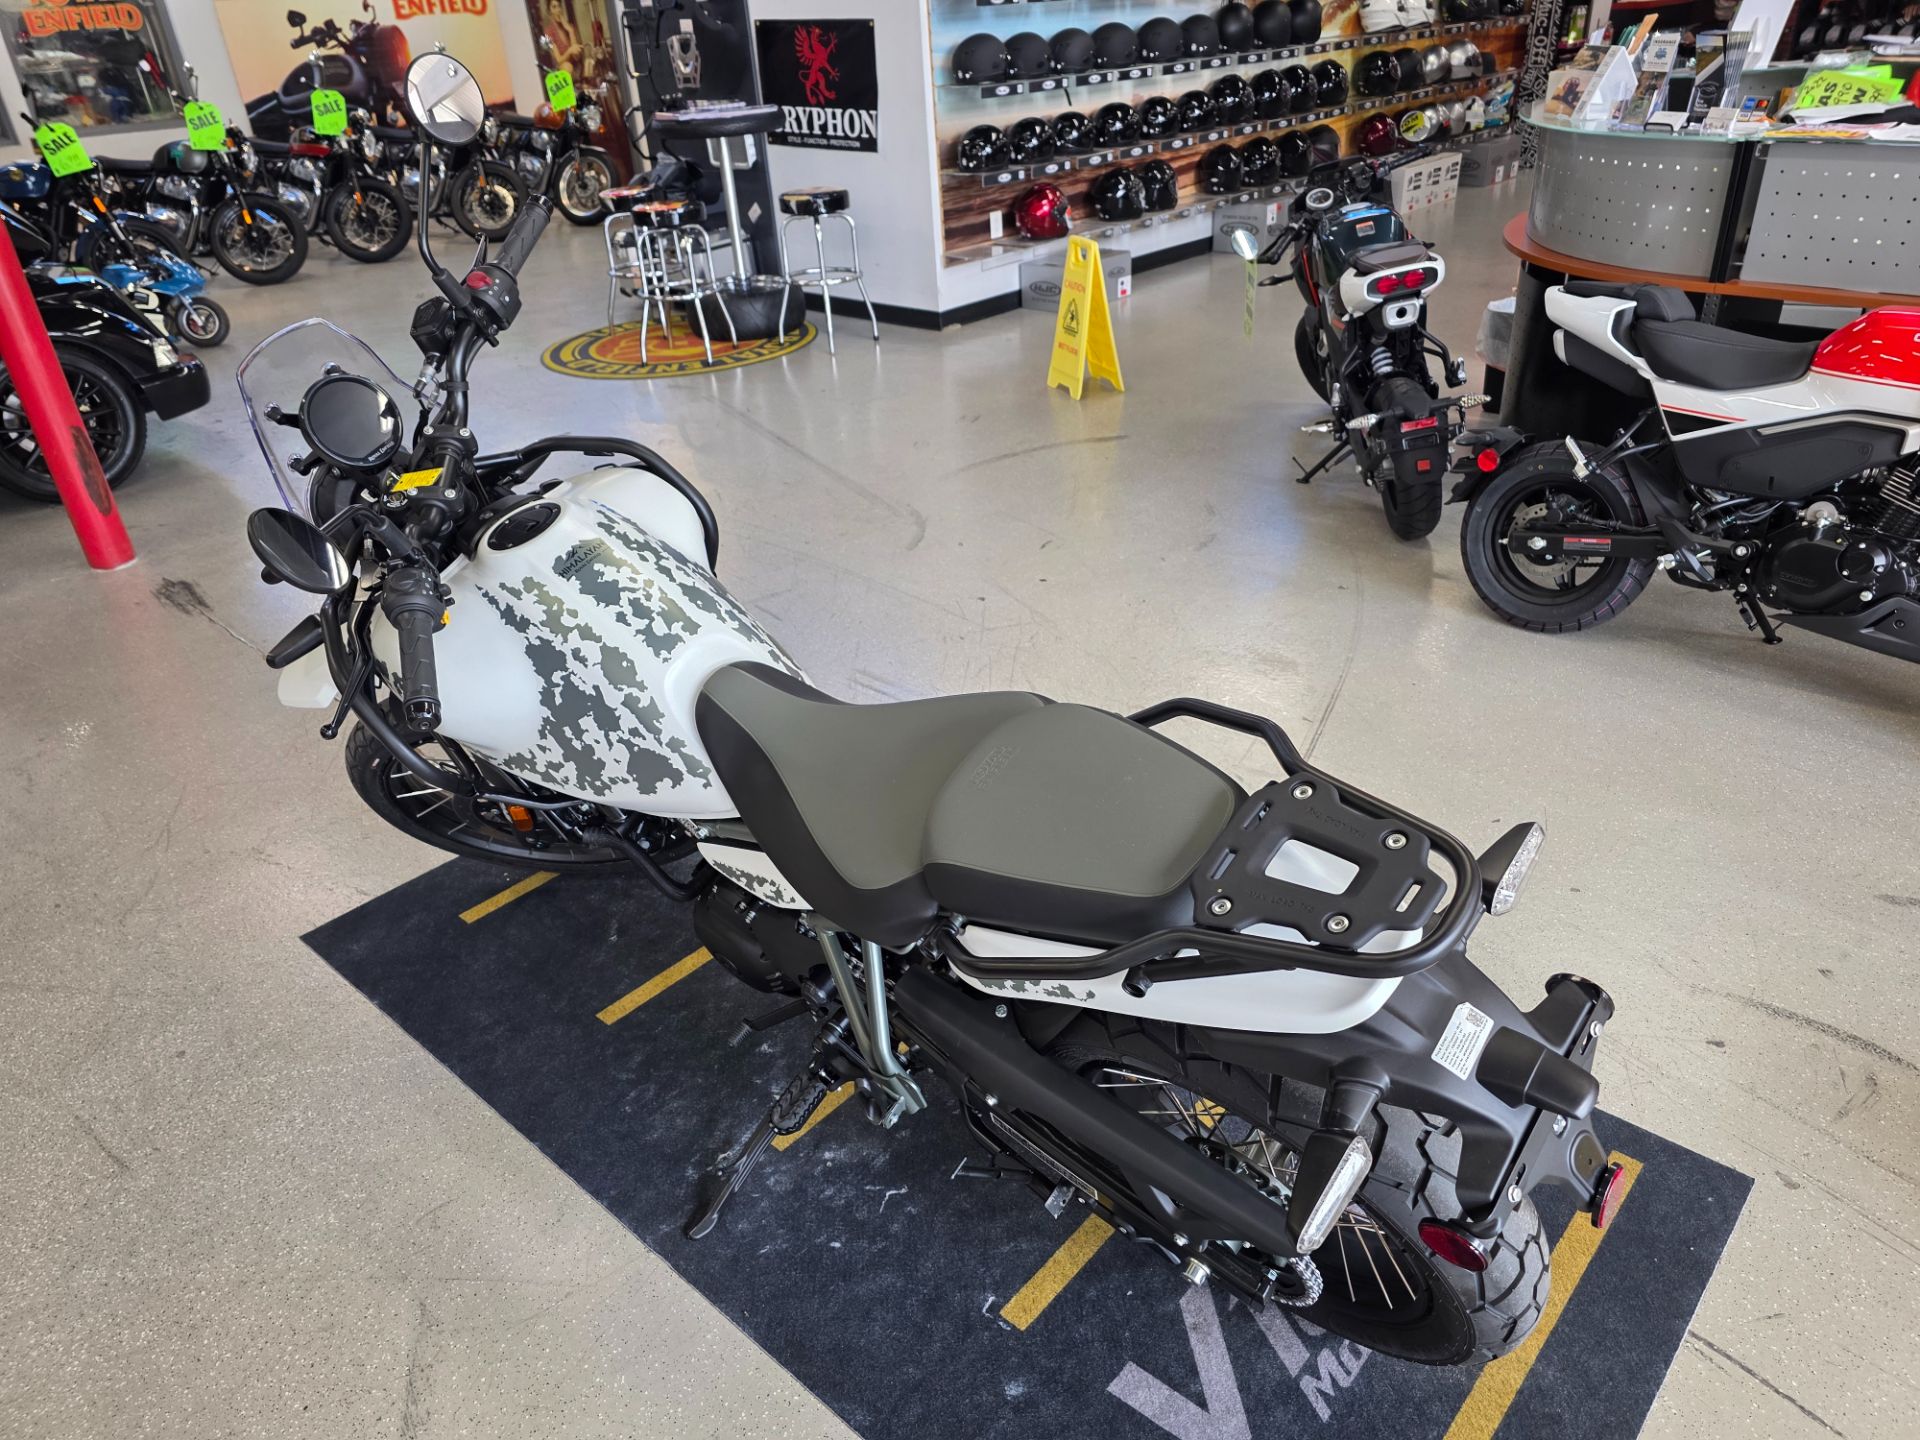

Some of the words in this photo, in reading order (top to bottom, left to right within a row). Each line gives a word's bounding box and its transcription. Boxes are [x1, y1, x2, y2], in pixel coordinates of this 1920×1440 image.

[23, 3, 143, 37] ENFIELD
[391, 0, 488, 20] ENFIELD
[551, 77, 570, 96] SALE
[315, 100, 343, 116] SALE
[189, 111, 220, 131] SALE
[774, 105, 878, 139] RYPHON
[43, 132, 77, 156] SALE
[559, 543, 605, 579] HIMALAYAN
